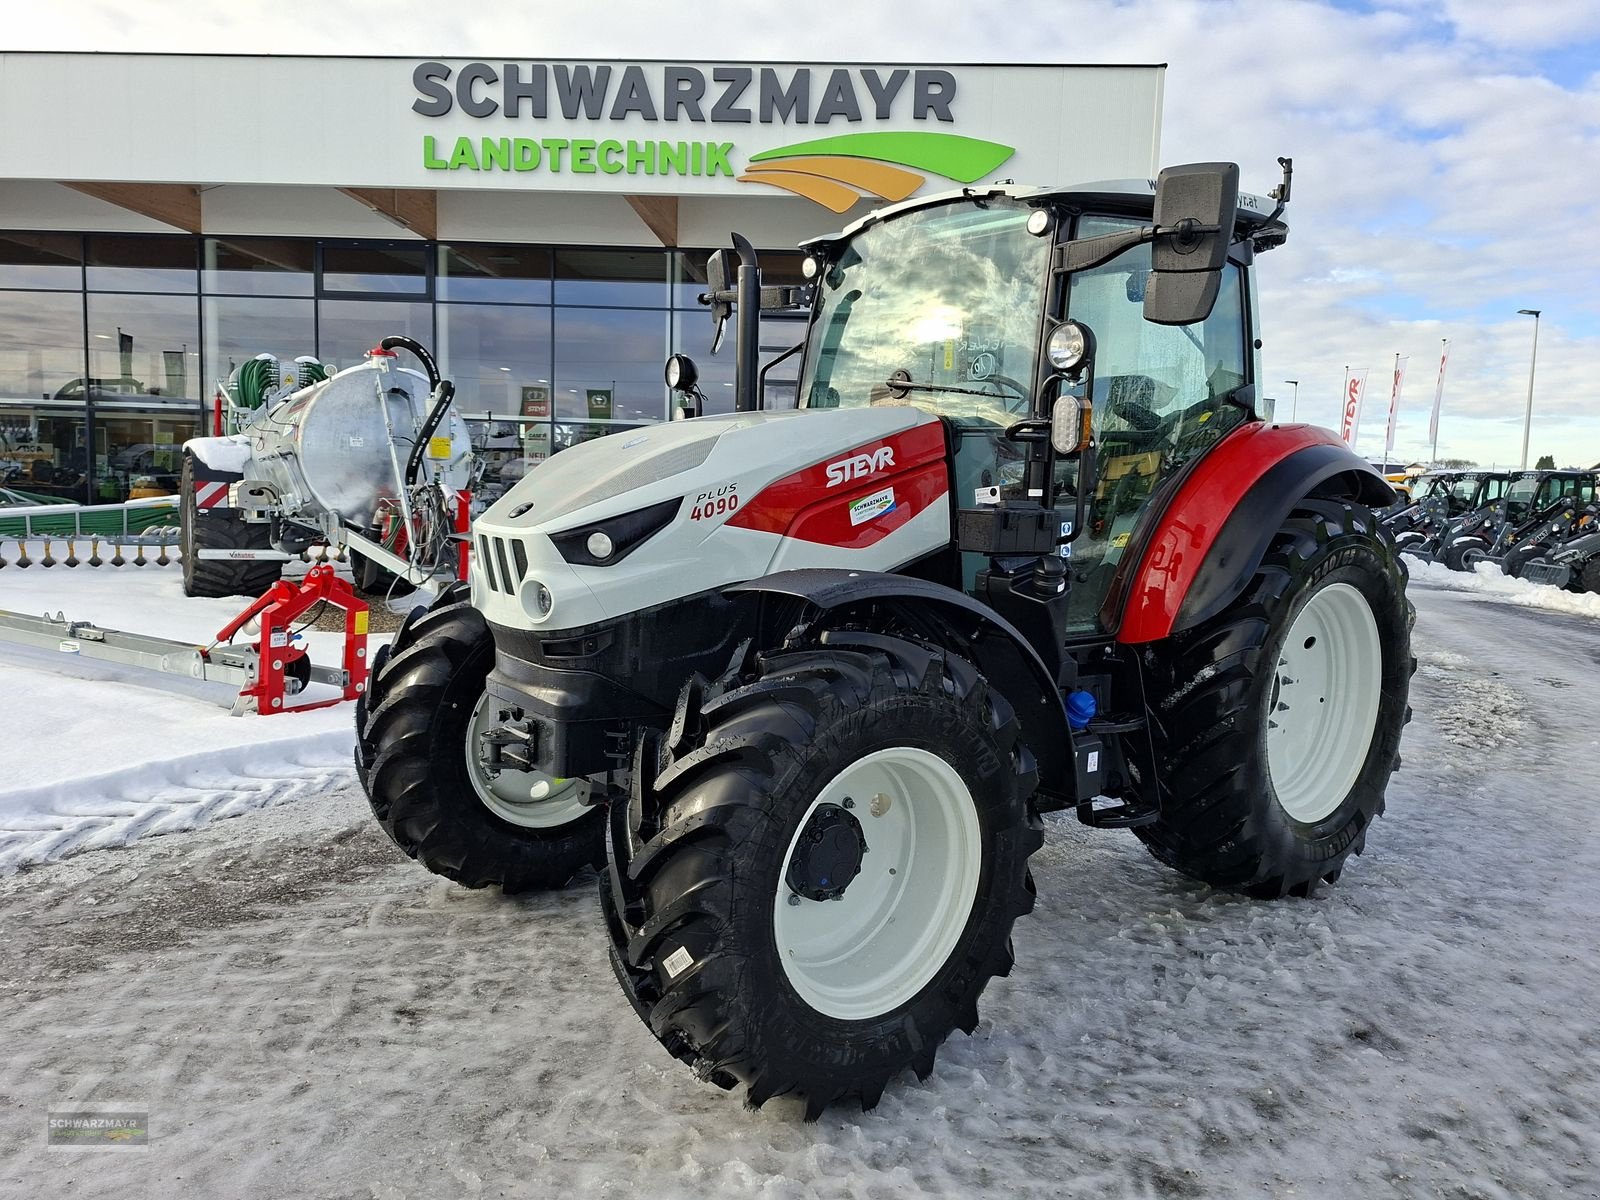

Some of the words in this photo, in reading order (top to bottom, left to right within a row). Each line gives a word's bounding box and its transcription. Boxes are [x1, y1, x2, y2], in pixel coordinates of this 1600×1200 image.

[411, 61, 957, 125] SCHWARZMAYR
[423, 135, 735, 178] LANDTECHNIK
[1342, 377, 1361, 443] STEYR
[826, 446, 896, 488] STEYR
[690, 494, 739, 521] 4090
[695, 482, 738, 504] PLUS
[853, 494, 889, 513] SCHWARZMAYR
